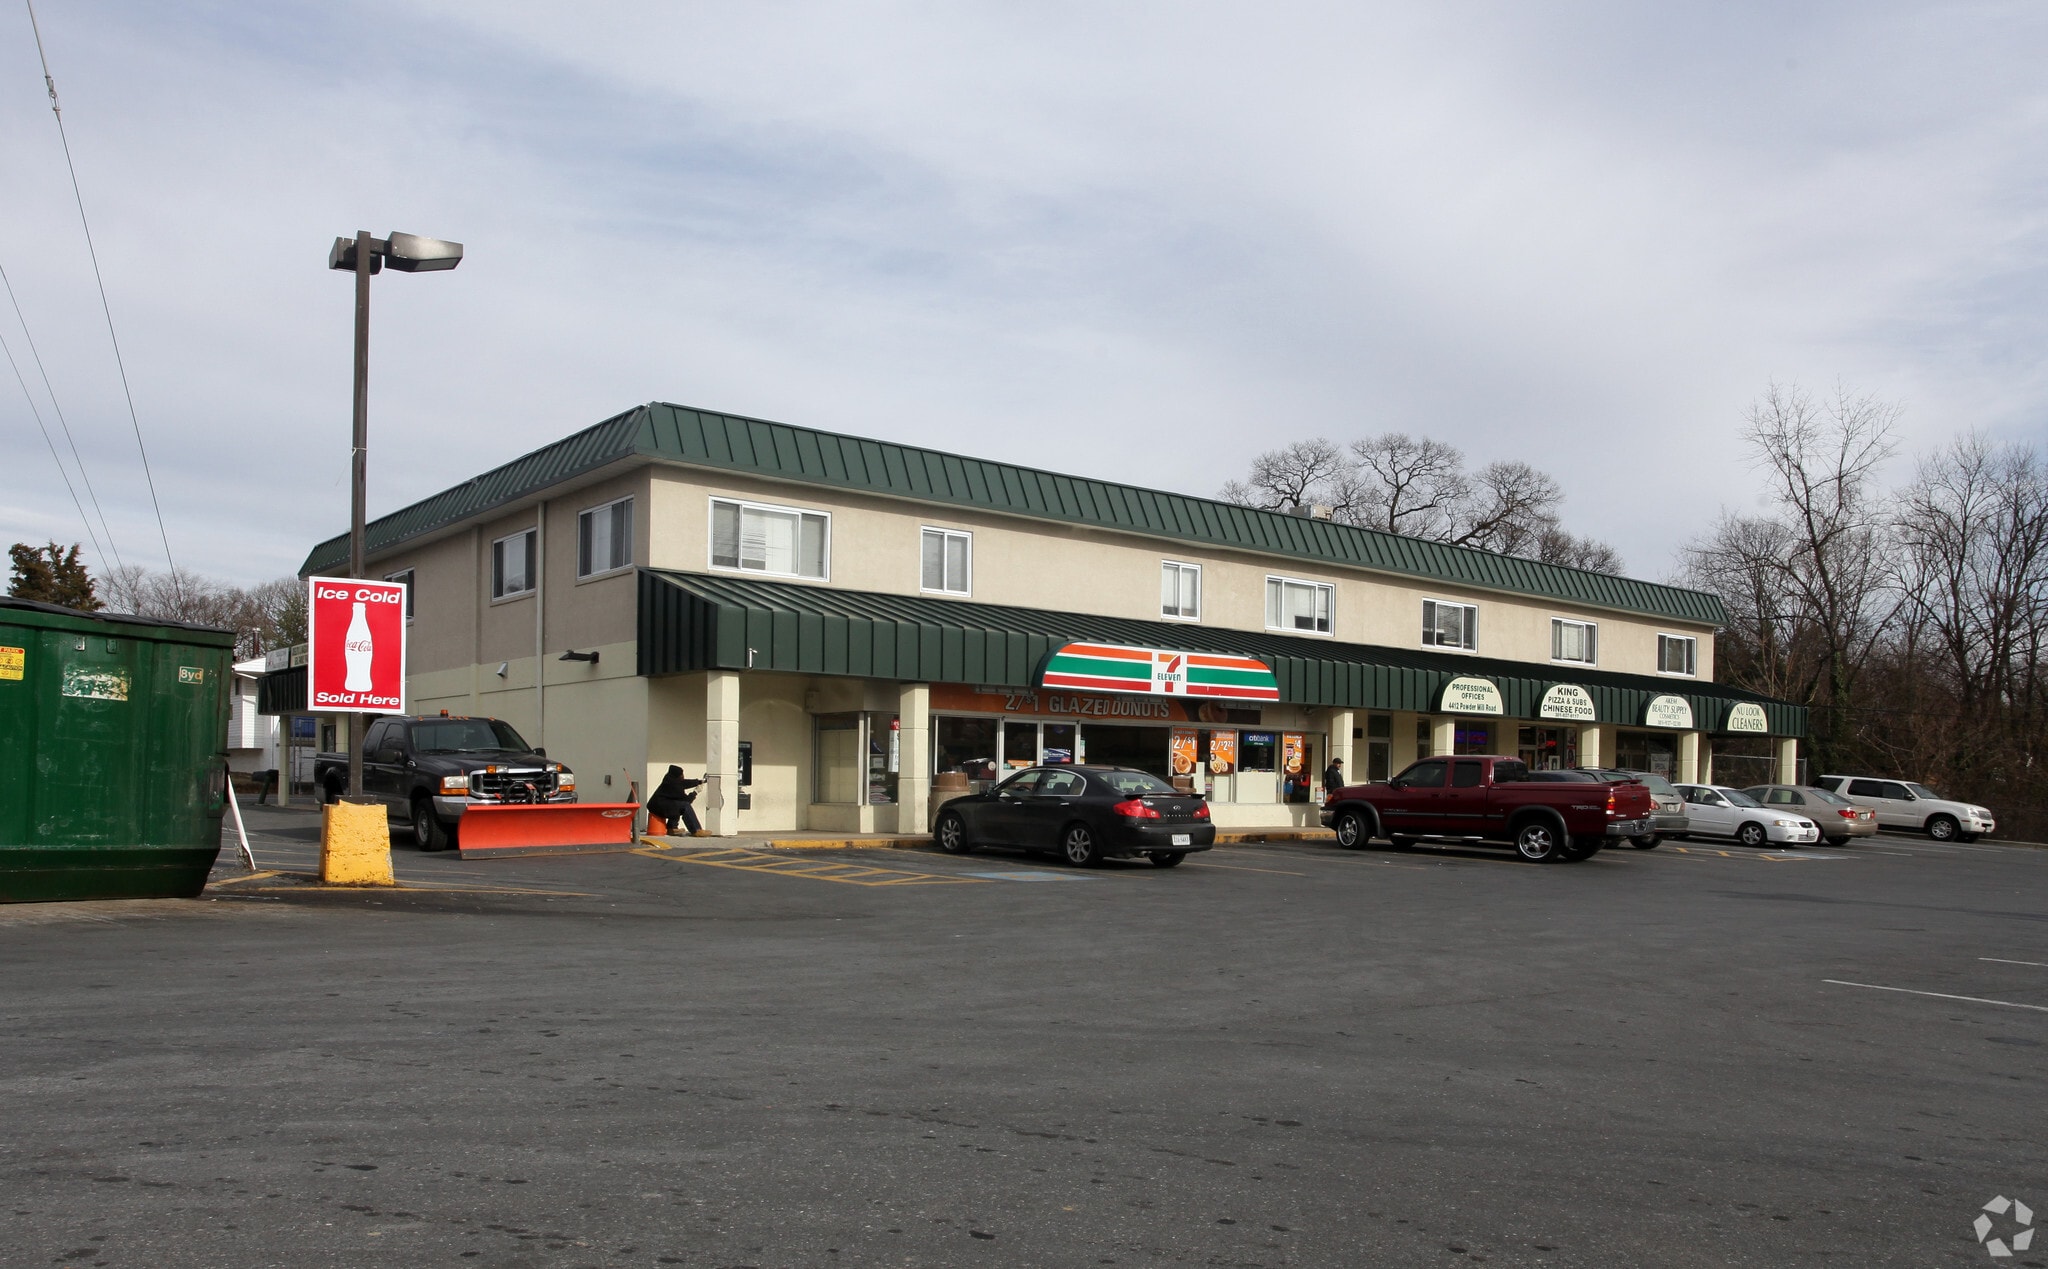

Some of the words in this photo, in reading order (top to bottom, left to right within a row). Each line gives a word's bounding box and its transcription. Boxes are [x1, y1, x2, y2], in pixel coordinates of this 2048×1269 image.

[317, 587, 349, 600] Ice
[355, 589, 400, 604] Cold
[1158, 653, 1181, 693] 7
[1452, 684, 1494, 693] PROFESSIONAL
[1557, 688, 1579, 696] KING
[316, 692, 355, 704] Sold
[360, 694, 400, 705] Here
[1049, 695, 1110, 716] GLAZED
[1111, 699, 1170, 718] DONUTS
[1543, 704, 1573, 713] CHINESE
[1574, 707, 1593, 715] FOOD
[1651, 704, 1670, 713] BEAUTY
[1670, 706, 1687, 715] SUPPLY
[1737, 706, 1745, 716] NU
[1732, 717, 1763, 731] CLEANERS
